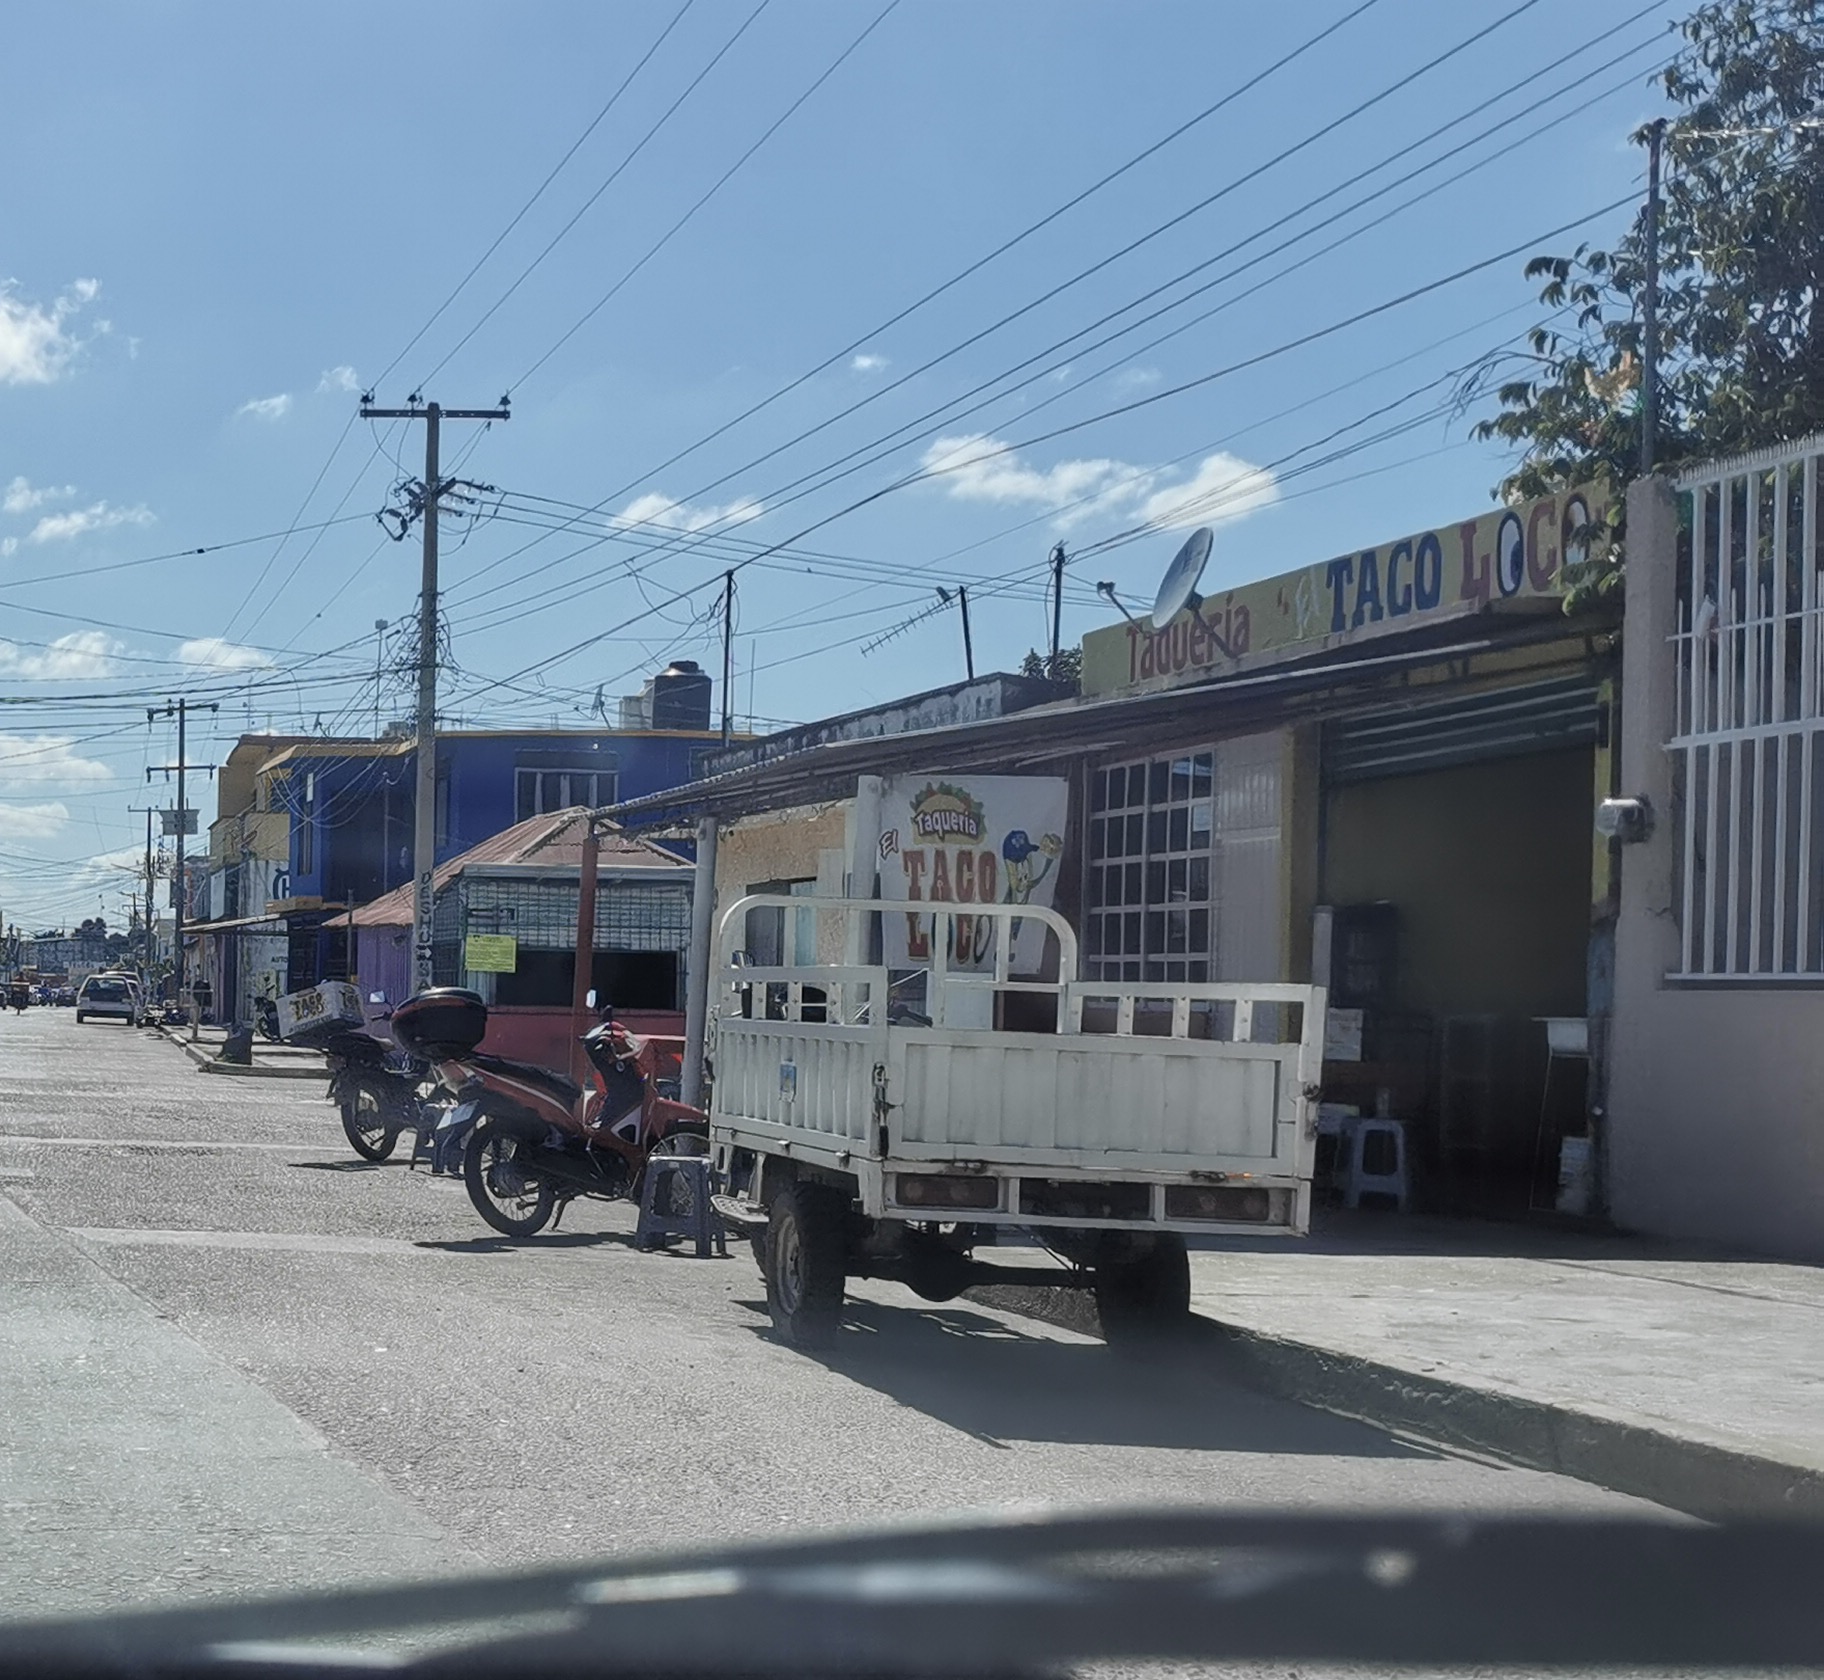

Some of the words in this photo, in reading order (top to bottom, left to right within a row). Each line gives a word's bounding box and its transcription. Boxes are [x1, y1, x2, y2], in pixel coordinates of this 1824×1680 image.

[1326, 532, 1442, 633] TACO
[879, 828, 899, 861] El
[914, 808, 979, 842] Taqueria
[902, 849, 996, 903] TACO
